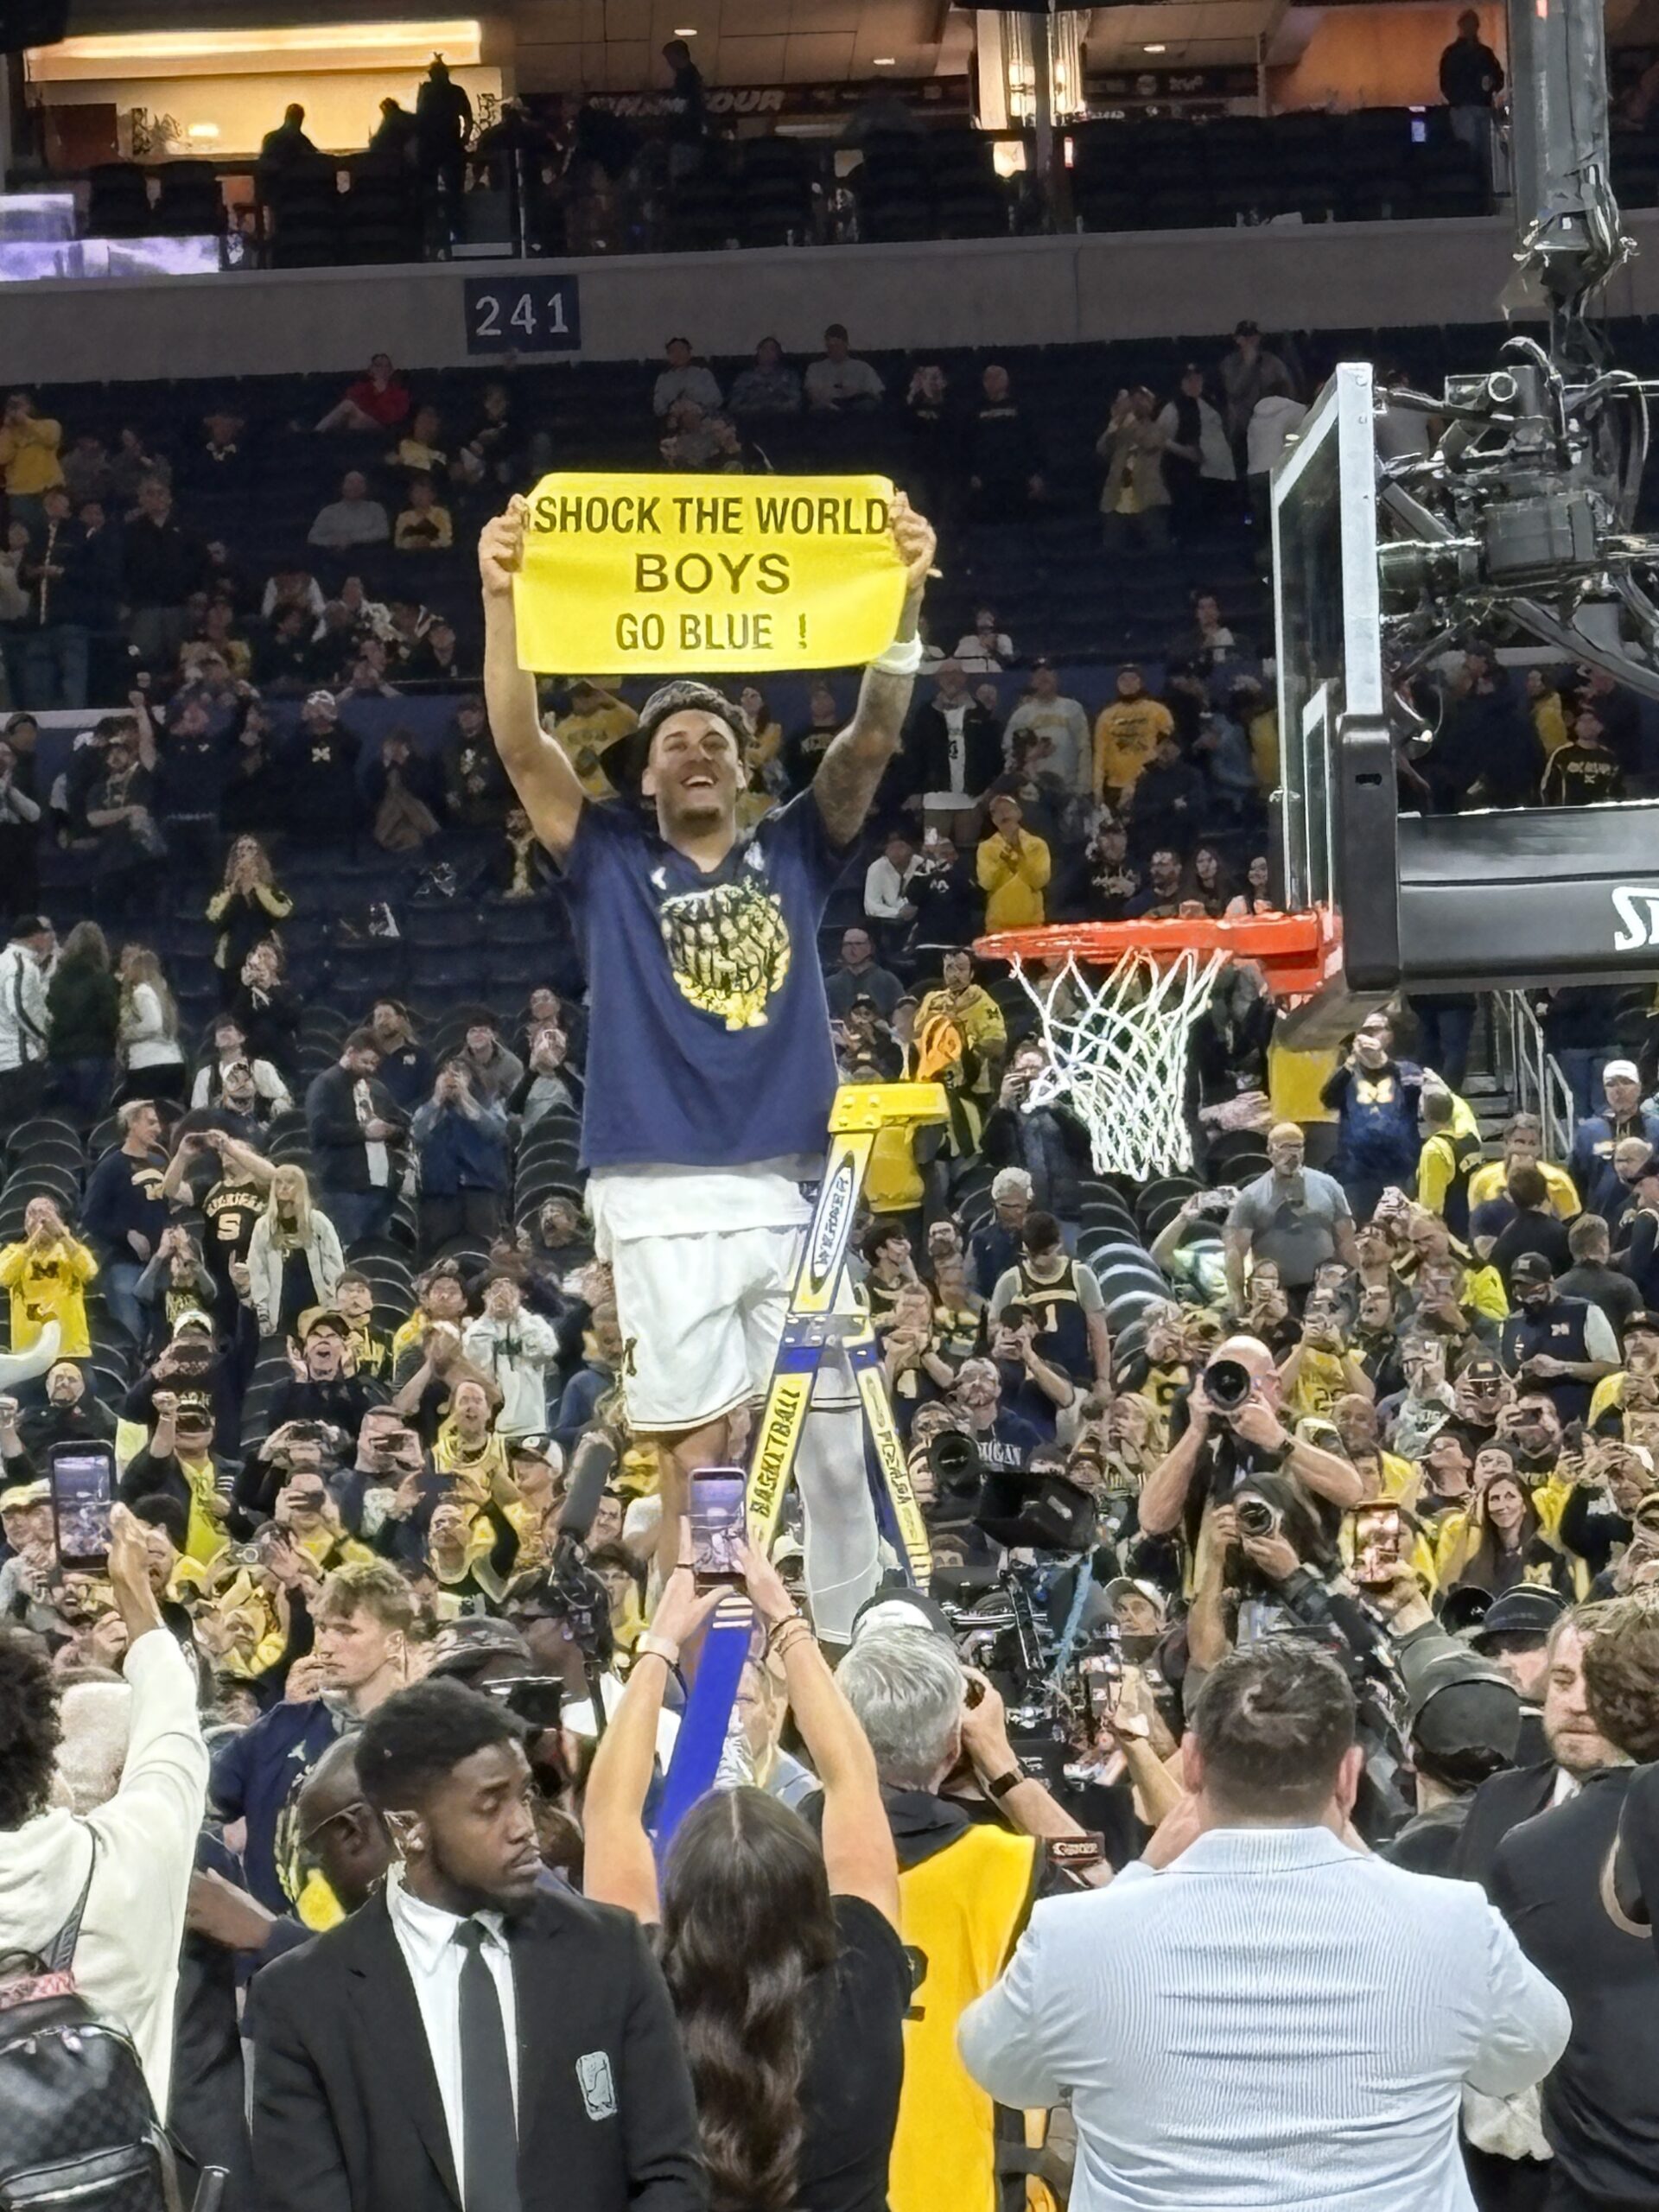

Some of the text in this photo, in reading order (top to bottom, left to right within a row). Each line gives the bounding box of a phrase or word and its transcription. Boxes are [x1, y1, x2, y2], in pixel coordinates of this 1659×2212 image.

[475, 293, 569, 335] 241
[534, 496, 888, 534] SHOCK THE WORLD
[634, 552, 790, 594] BOYS
[616, 613, 807, 650] GO BLUE !
